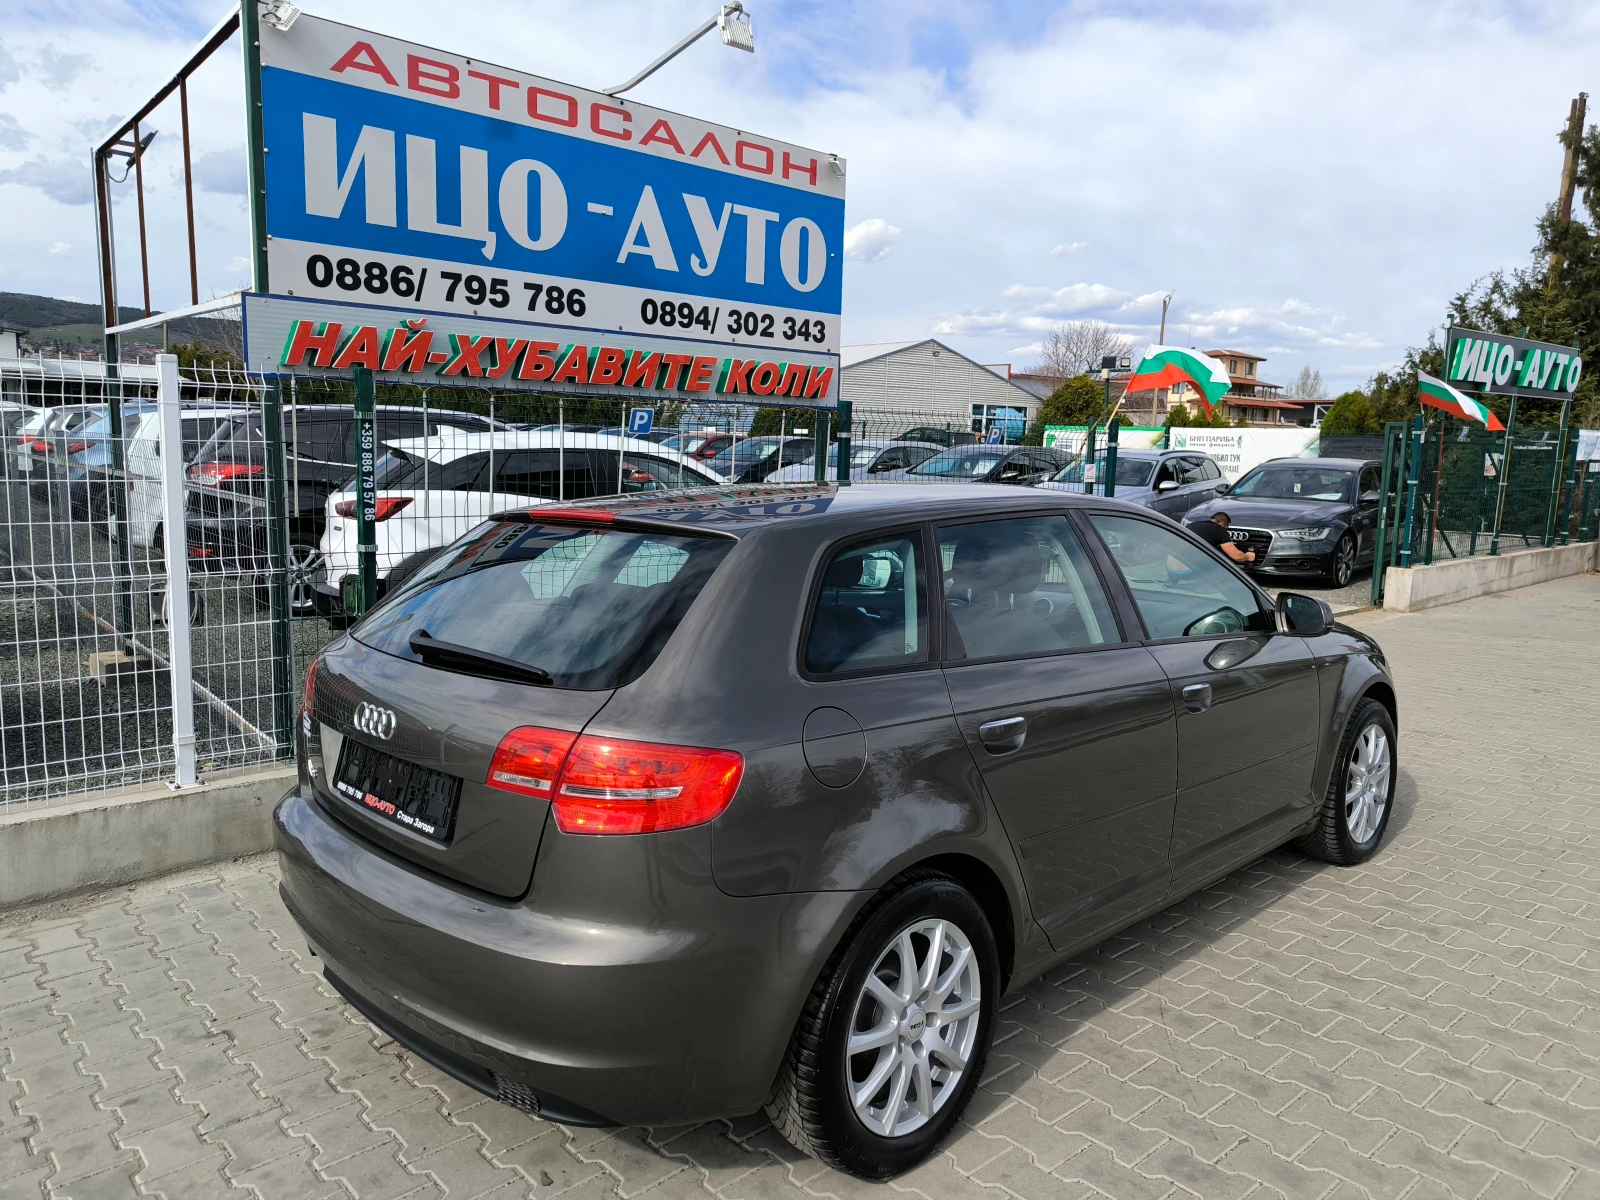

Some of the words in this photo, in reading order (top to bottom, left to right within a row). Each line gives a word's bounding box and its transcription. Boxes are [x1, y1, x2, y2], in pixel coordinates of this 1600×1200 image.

[330, 41, 818, 186] АВТОСАЛОН
[306, 254, 427, 301] 0886/
[440, 271, 511, 308] 795
[523, 281, 587, 318] 786
[640, 298, 720, 334] 0894/
[727, 309, 775, 338] 302
[782, 316, 826, 344] 343
[280, 318, 717, 391] НАЙ-ХУБАВИТЕ
[717, 357, 834, 398] КОЛИ
[1451, 338, 1582, 393] ИЦО-АУТО
[361, 422, 373, 449] +359
[361, 452, 373, 472] 886
[362, 475, 374, 488] 79
[363, 491, 375, 505] 57
[364, 508, 376, 521] 86
[397, 810, 414, 825] Стара
[413, 818, 435, 834] Загора
